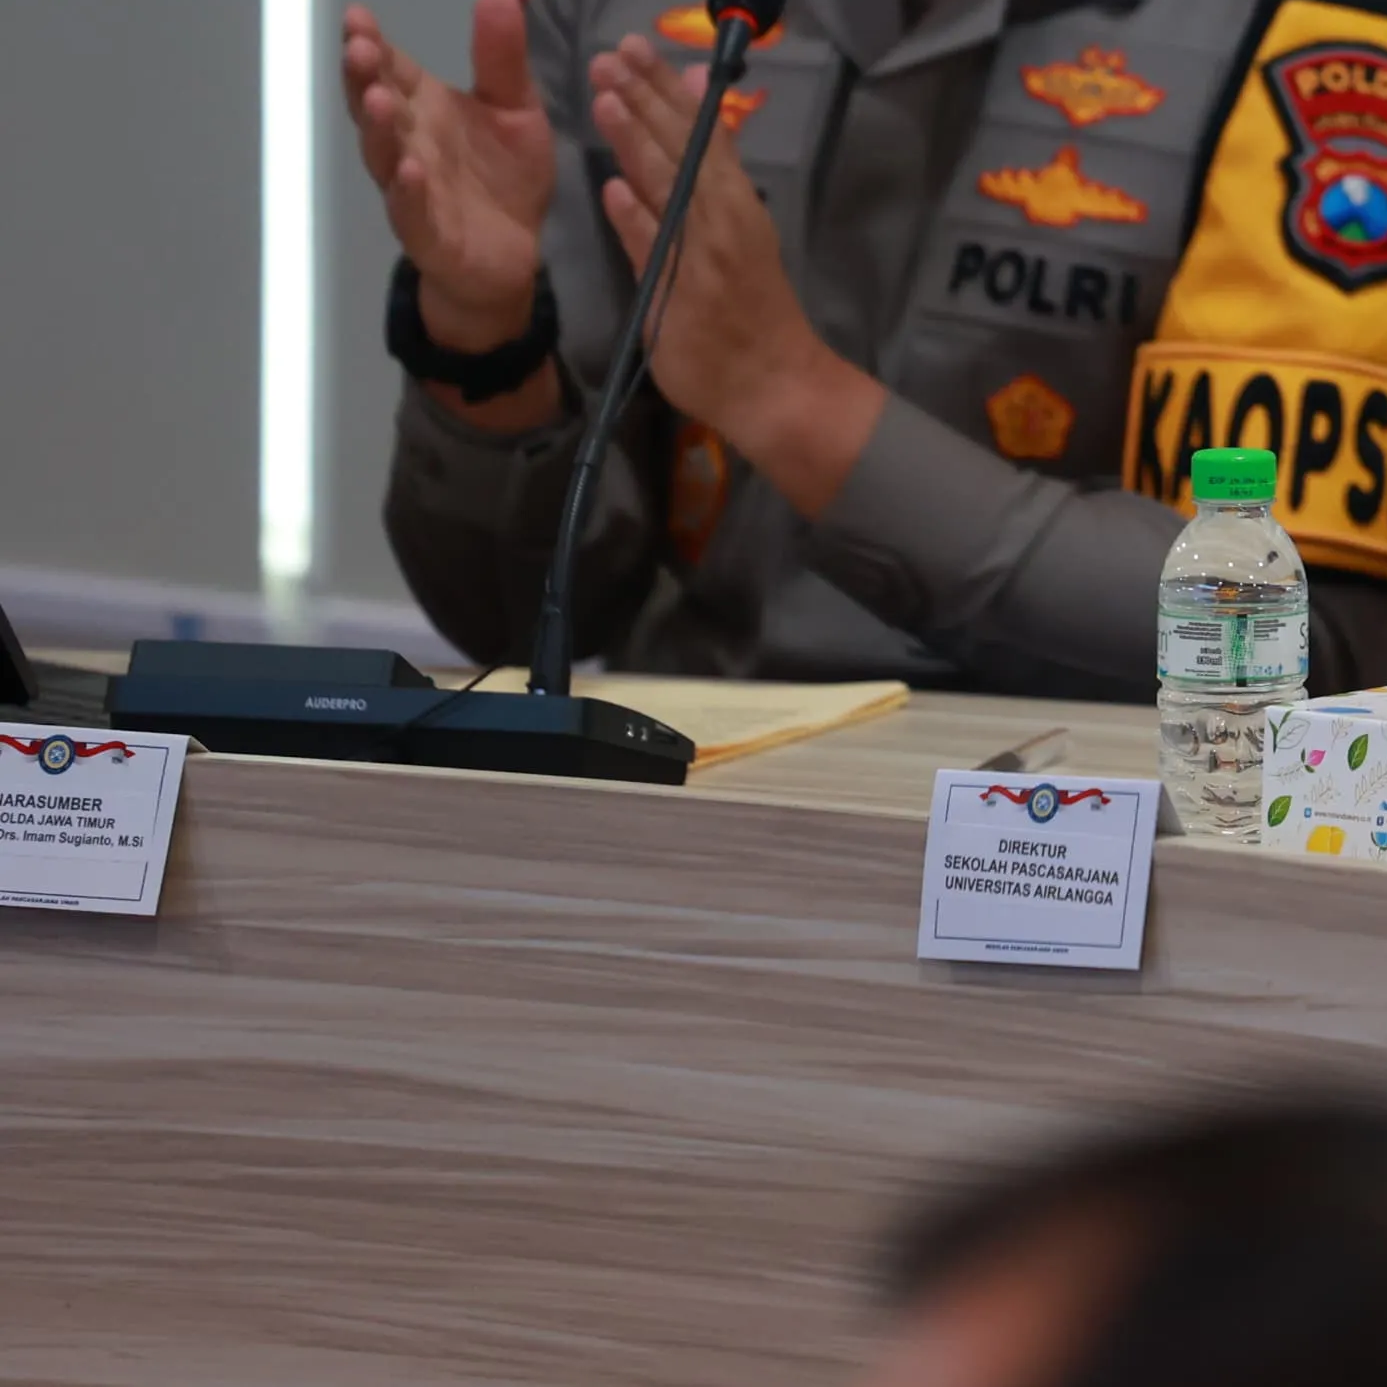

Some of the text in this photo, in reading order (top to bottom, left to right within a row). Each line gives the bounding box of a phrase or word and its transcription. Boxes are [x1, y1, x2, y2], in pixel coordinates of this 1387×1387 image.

[948, 241, 1140, 325] POLRI
[304, 696, 368, 711] AUDERPRO
[0, 793, 103, 812] ARASUMBER
[37, 814, 73, 827] JAWA
[76, 816, 116, 830] TIMUR
[23, 830, 56, 844] Imam
[58, 832, 114, 848] Sugianto,
[117, 835, 144, 847] M.Si
[998, 839, 1067, 859] DIREKTUR
[944, 854, 1120, 886] SEKOLAH PASCASARJANA
[944, 875, 1114, 906] UNIVERSITAS AIRLANGGA
